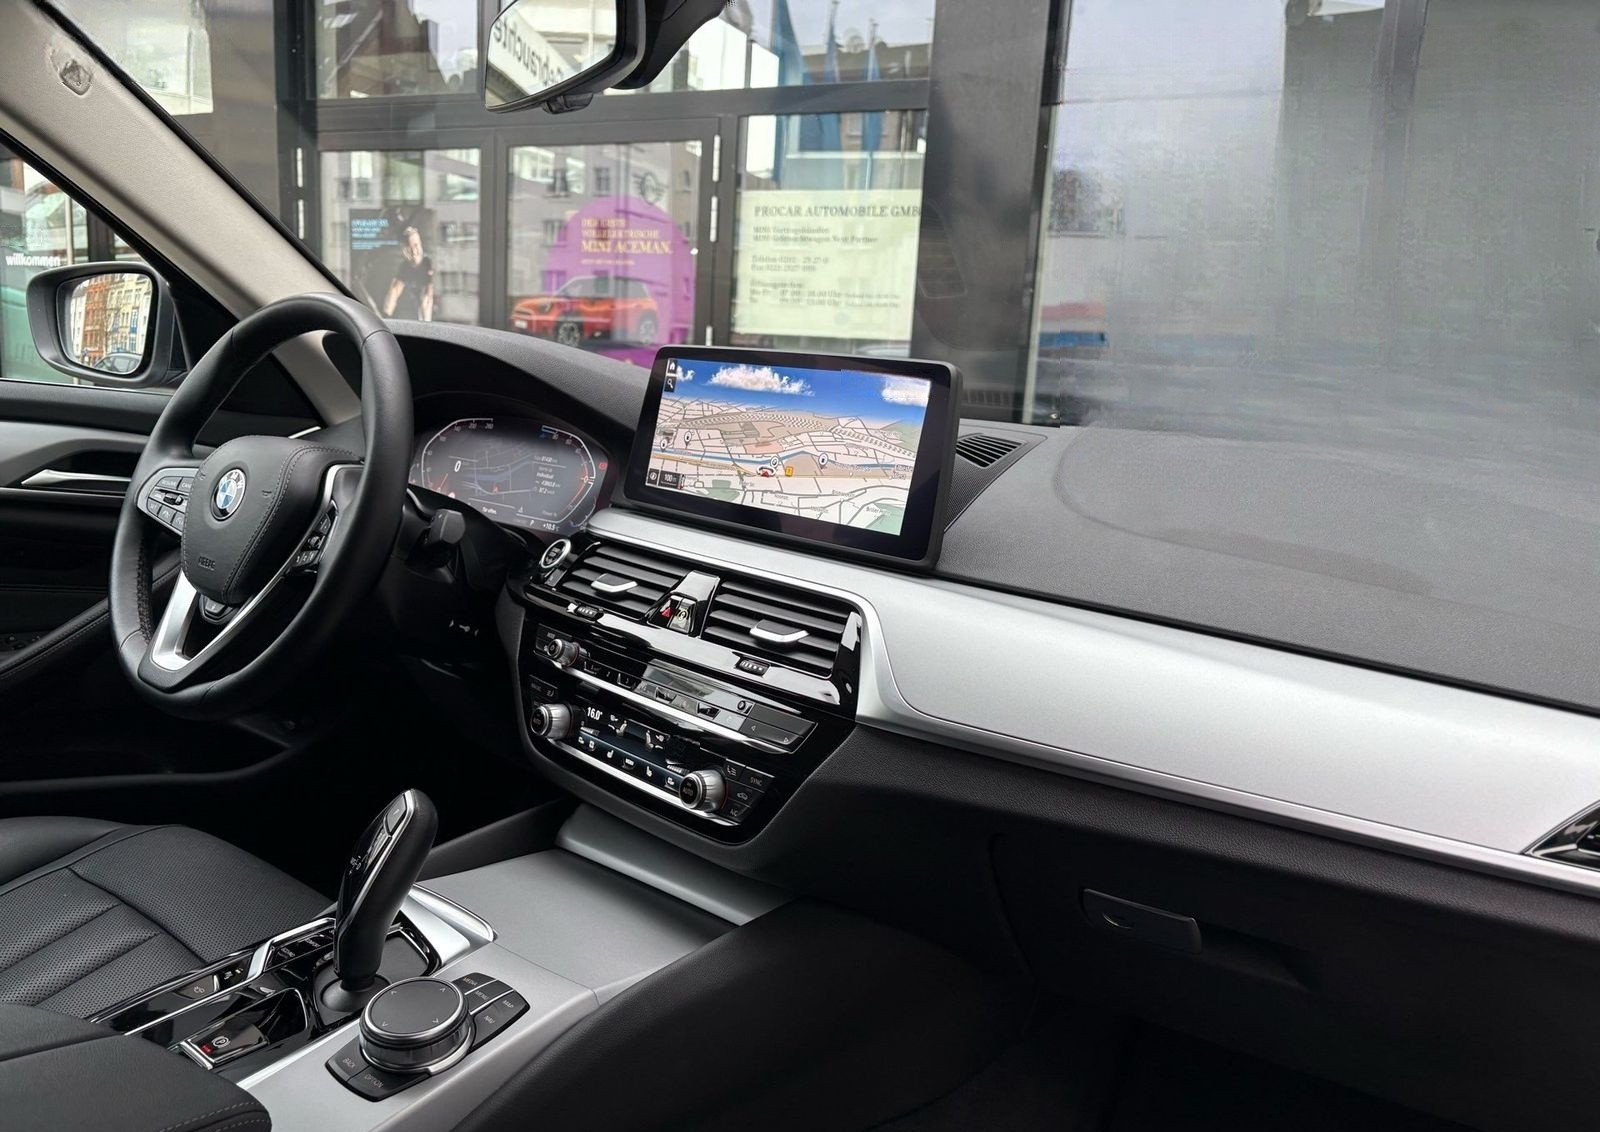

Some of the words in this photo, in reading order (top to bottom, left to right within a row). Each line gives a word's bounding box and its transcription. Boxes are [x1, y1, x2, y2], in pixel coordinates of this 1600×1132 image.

[754, 205, 802, 218] PROCAR
[805, 205, 888, 218] AUTOMOBILE
[581, 239, 612, 253] MINI
[5, 252, 61, 268] willkommen
[454, 460, 462, 473] 0
[664, 473, 673, 483] 100
[750, 776, 763, 786] SYNC
[502, 999, 514, 1008] MAP
[484, 1015, 496, 1024] NAV
[364, 1073, 384, 1088] OPTION
